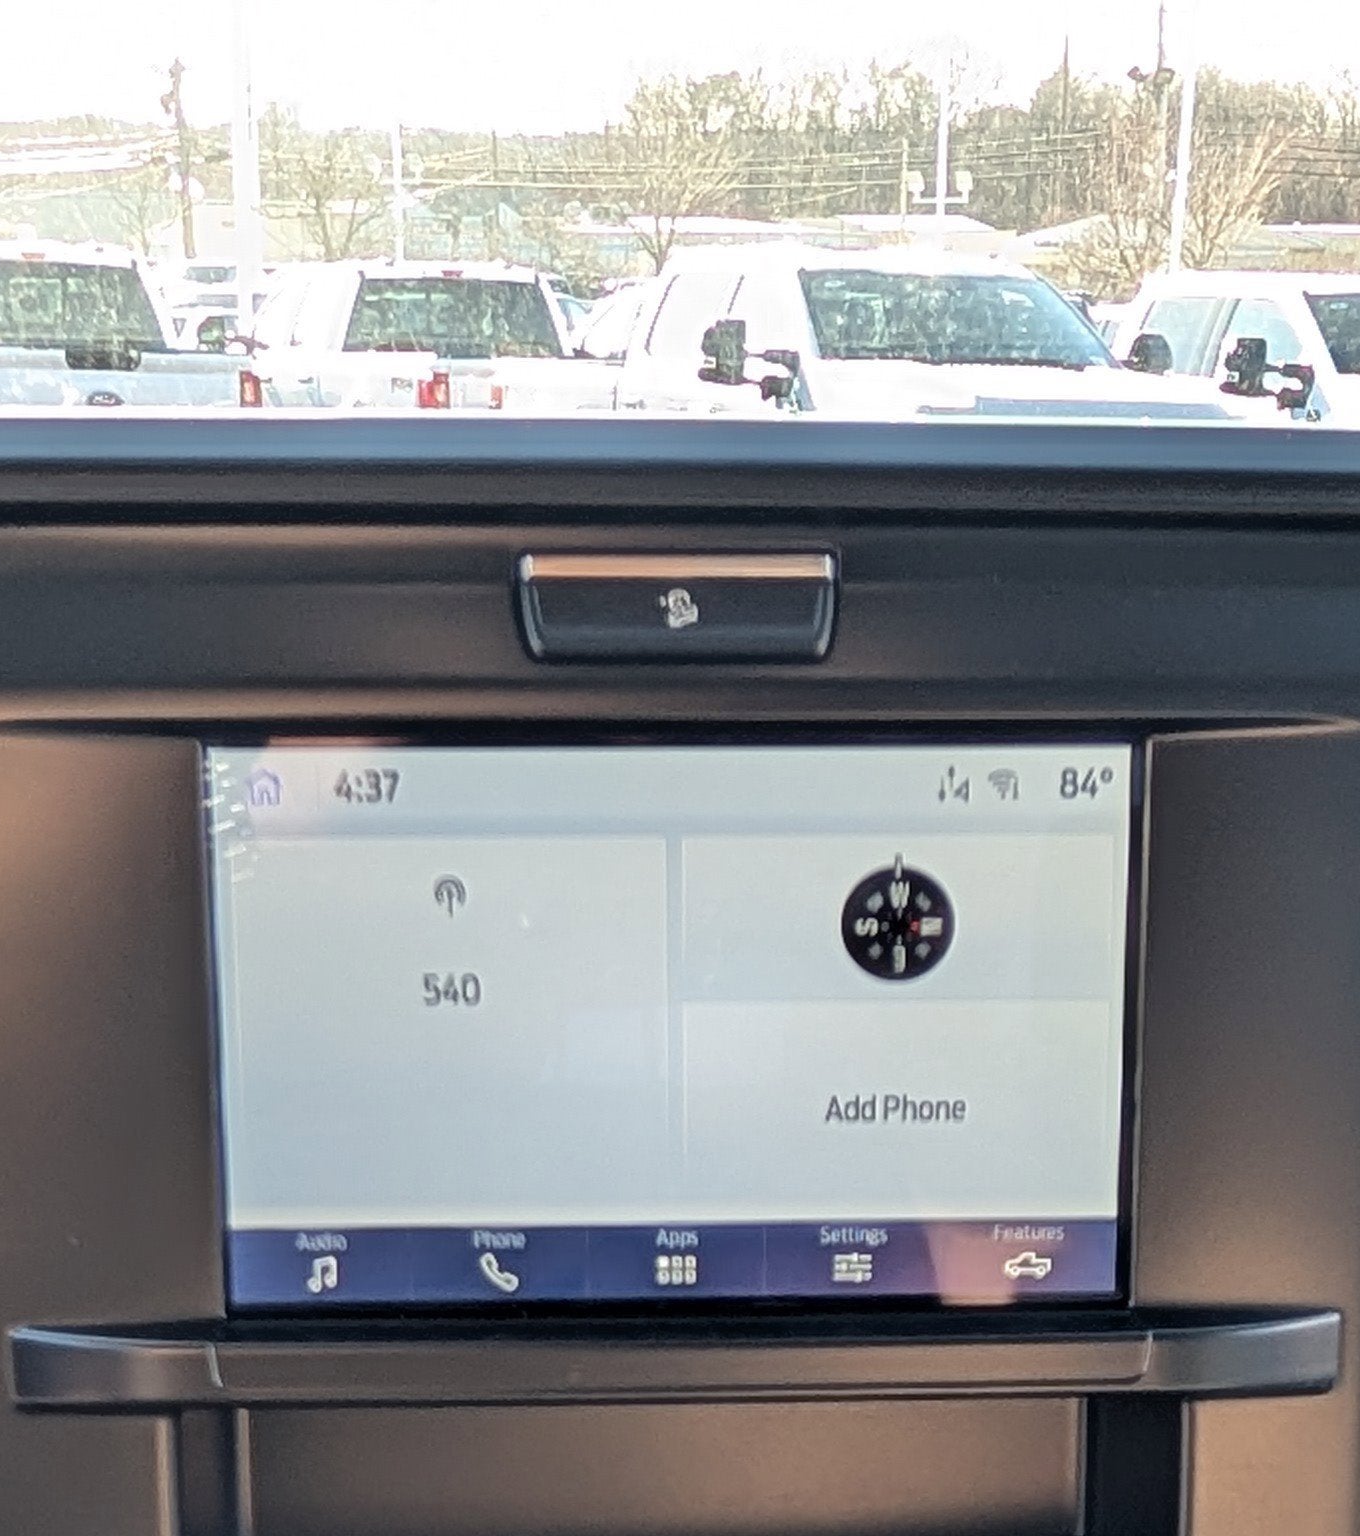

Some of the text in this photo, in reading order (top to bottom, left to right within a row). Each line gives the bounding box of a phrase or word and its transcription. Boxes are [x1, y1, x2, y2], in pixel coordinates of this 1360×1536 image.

[334, 770, 400, 804] 4:37
[1059, 766, 1113, 801] 84°
[422, 973, 480, 1007] 540
[824, 1091, 967, 1122] Add Phone
[296, 1232, 348, 1251] Audio
[472, 1229, 527, 1250] Phone
[656, 1226, 699, 1249] Apps
[820, 1225, 889, 1247] Settings
[994, 1222, 1066, 1241] Features
